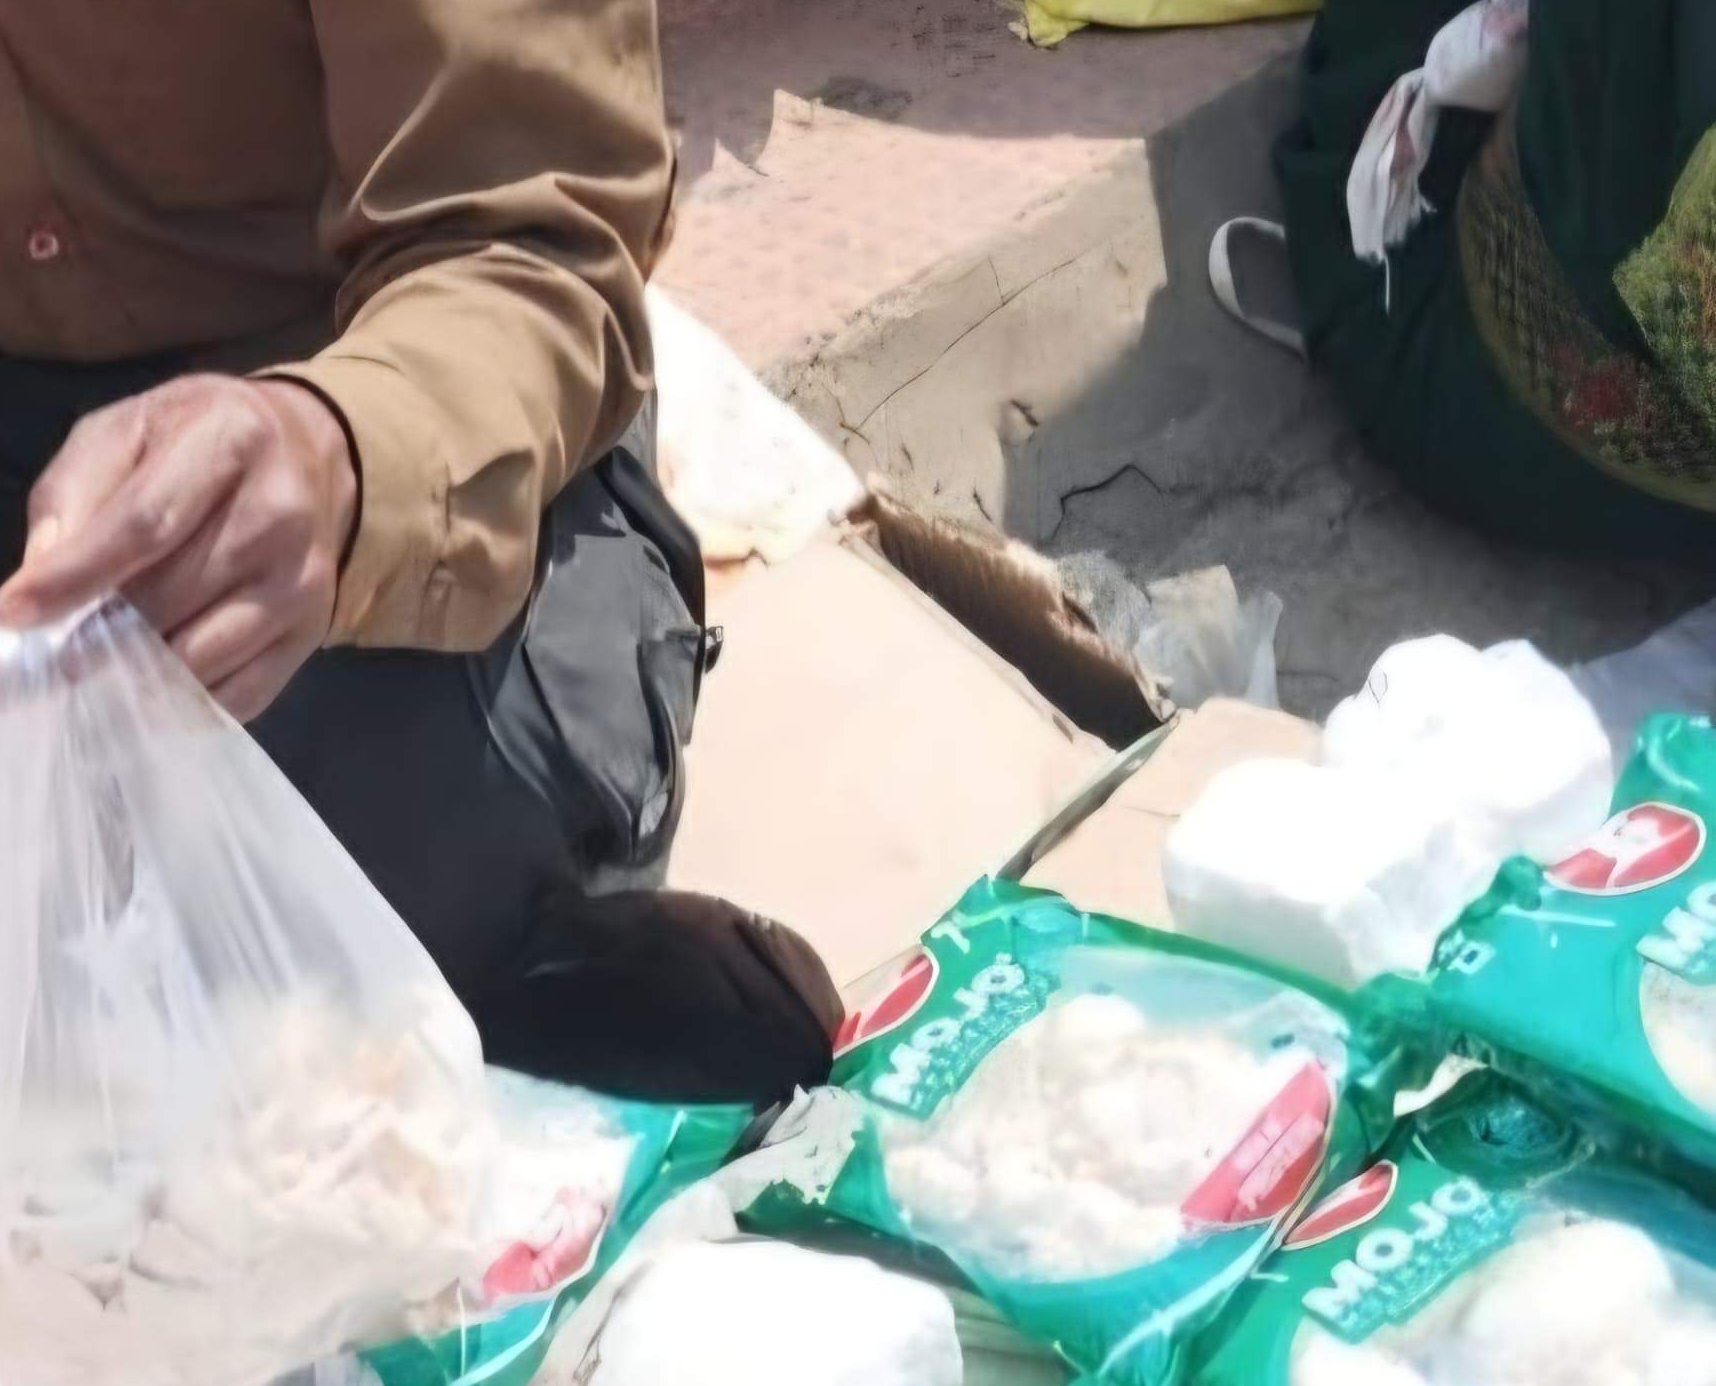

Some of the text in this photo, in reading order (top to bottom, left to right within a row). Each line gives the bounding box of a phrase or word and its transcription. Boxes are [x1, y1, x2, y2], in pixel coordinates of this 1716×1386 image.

[1636, 880, 1716, 979] MO
[870, 963, 1026, 1105] MOJO
[1301, 1177, 1483, 1320] MOJO
